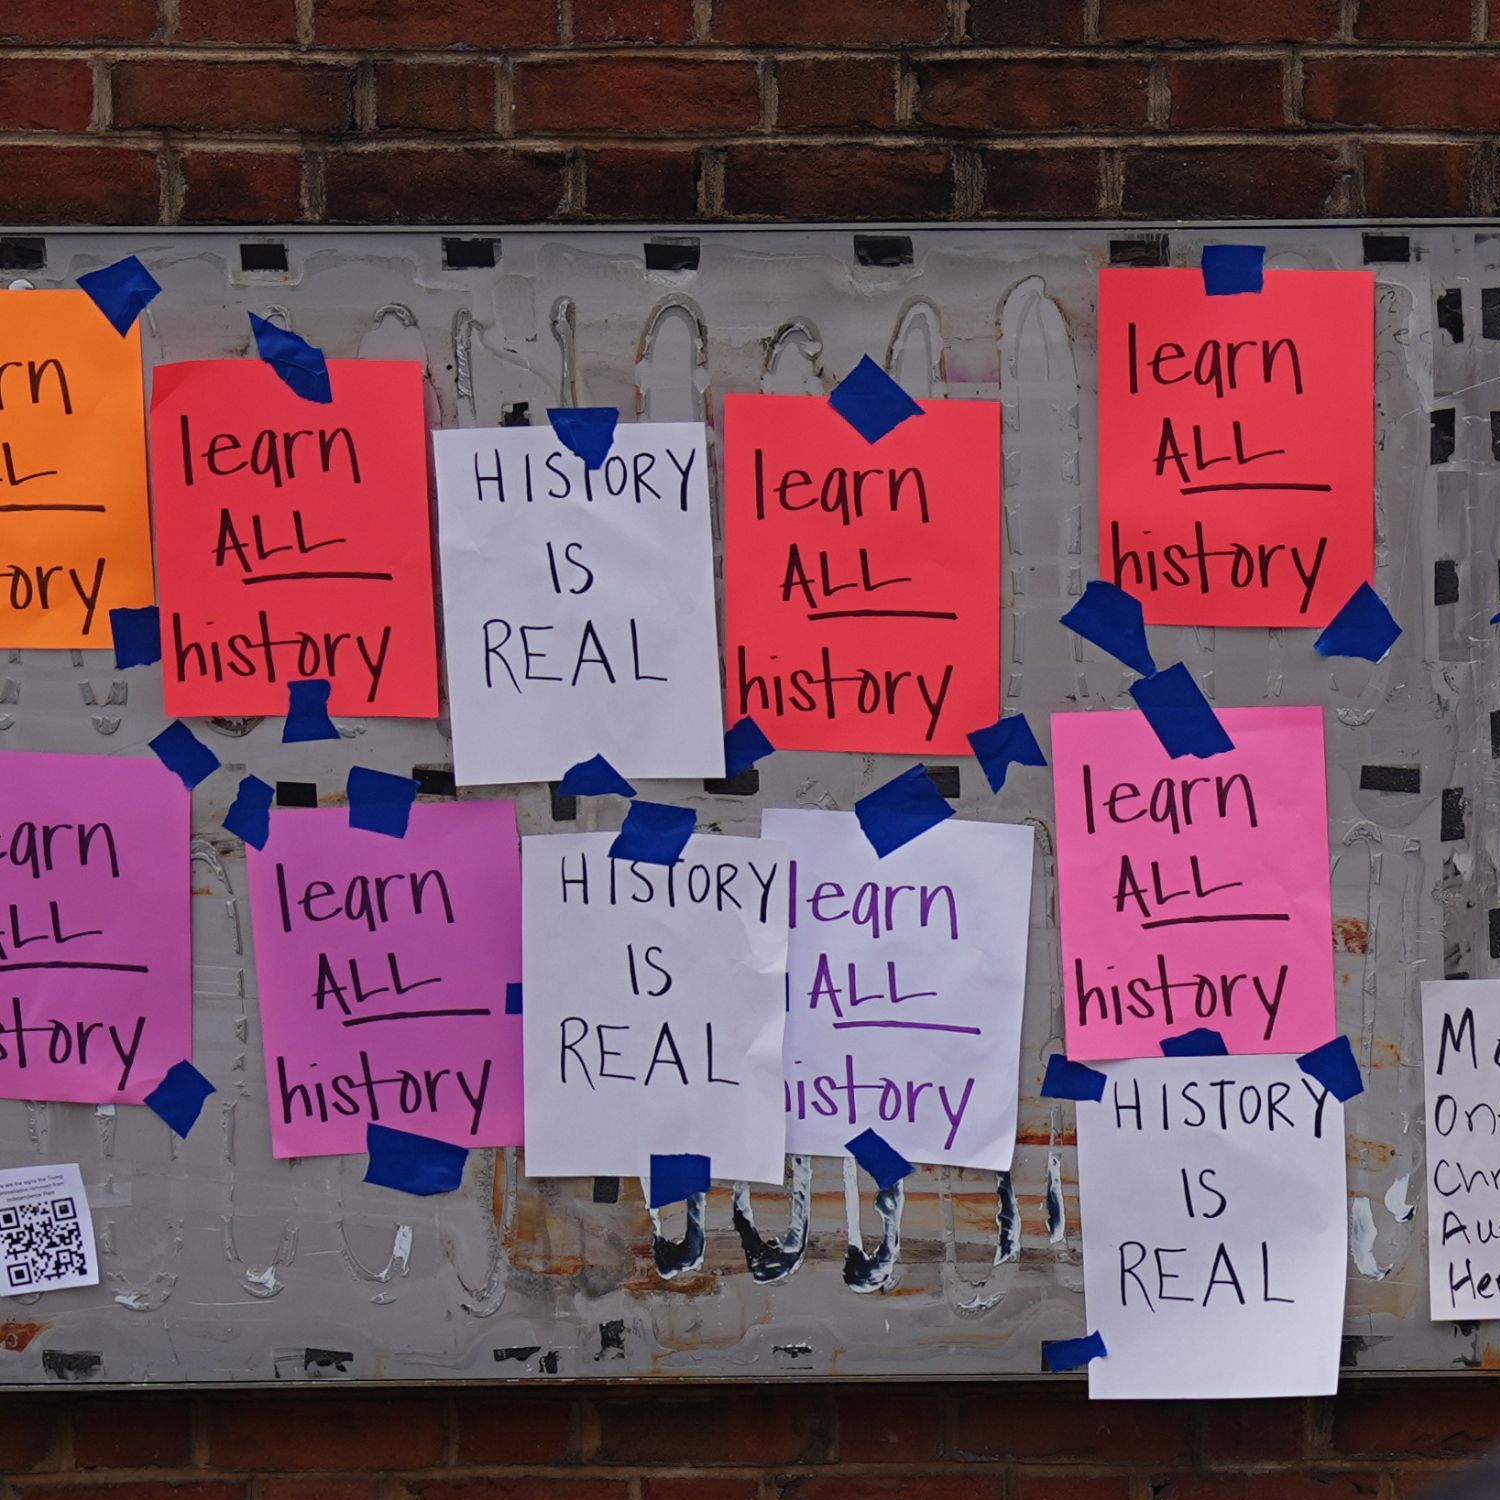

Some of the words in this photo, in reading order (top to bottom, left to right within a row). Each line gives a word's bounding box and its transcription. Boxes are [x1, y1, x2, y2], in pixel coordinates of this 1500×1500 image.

[1129, 322, 1303, 398] learn
[180, 415, 360, 486] learn
[1156, 417, 1286, 482] ALL
[754, 449, 929, 525] learn
[212, 508, 346, 572] ALL
[546, 541, 594, 594] IS
[1111, 520, 1327, 613] history
[781, 543, 911, 608] ALL
[173, 611, 391, 702] history
[482, 618, 668, 693] REAL
[738, 646, 953, 741] history
[1082, 764, 1258, 835] learn
[0, 821, 120, 879] arn
[275, 863, 454, 932] learn
[561, 855, 777, 923] HISTORY
[788, 860, 958, 940] learn
[1113, 855, 1242, 917] ALL
[0, 901, 103, 960] LL
[312, 952, 441, 1015] ALL
[627, 944, 672, 997] IS
[809, 953, 937, 1018] ALL
[1074, 954, 1288, 1040] history
[0, 997, 146, 1091] tory
[560, 1016, 739, 1090] REAL
[276, 1051, 491, 1135] history
[1114, 1078, 1331, 1138] HISTORY
[1180, 1167, 1226, 1219] IS
[1118, 1240, 1294, 1312] REAL
